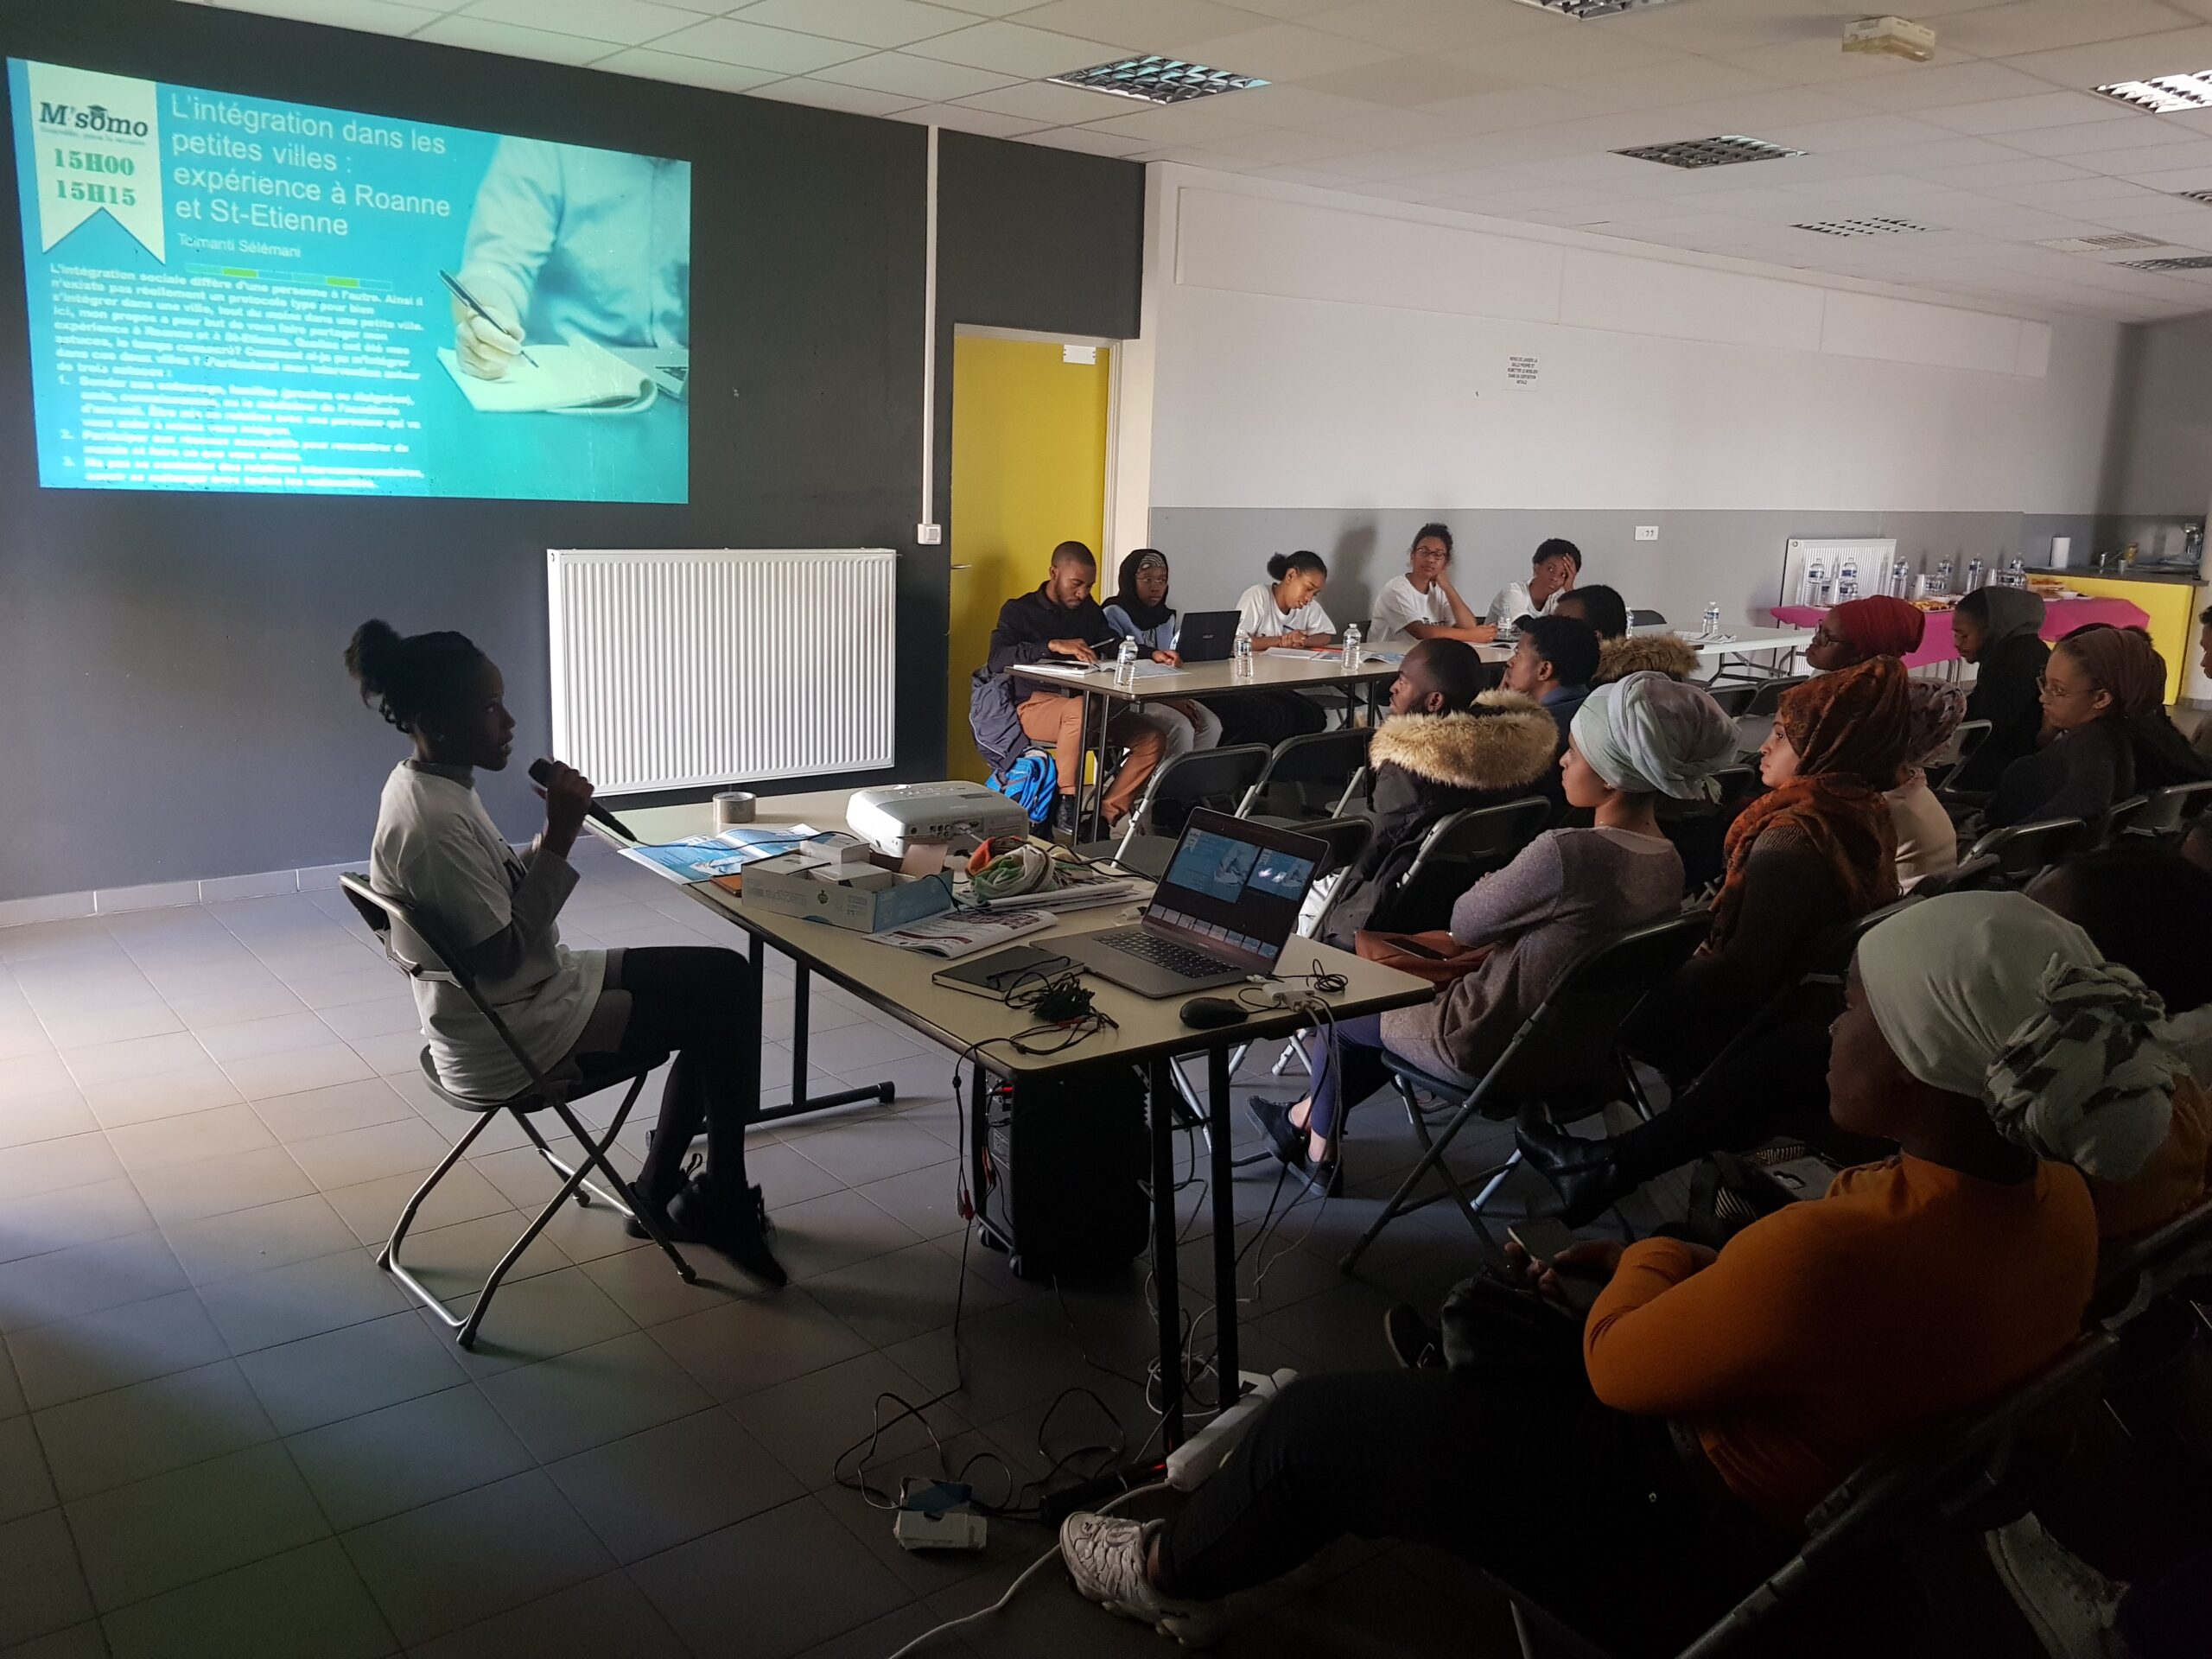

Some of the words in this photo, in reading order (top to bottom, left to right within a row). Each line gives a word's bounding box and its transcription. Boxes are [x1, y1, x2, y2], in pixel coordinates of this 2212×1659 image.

[36, 100, 149, 137] M'somo
[171, 93, 334, 139] L'intégration
[341, 118, 404, 149] dans
[410, 129, 446, 155] les
[54, 148, 136, 176] 15H00
[171, 132, 263, 162] petites
[272, 143, 338, 172] villes
[56, 179, 137, 207] 15H15
[173, 167, 321, 201] expérience
[354, 183, 451, 217] Roanne
[175, 195, 202, 220] et
[209, 198, 349, 236] St-Etienne
